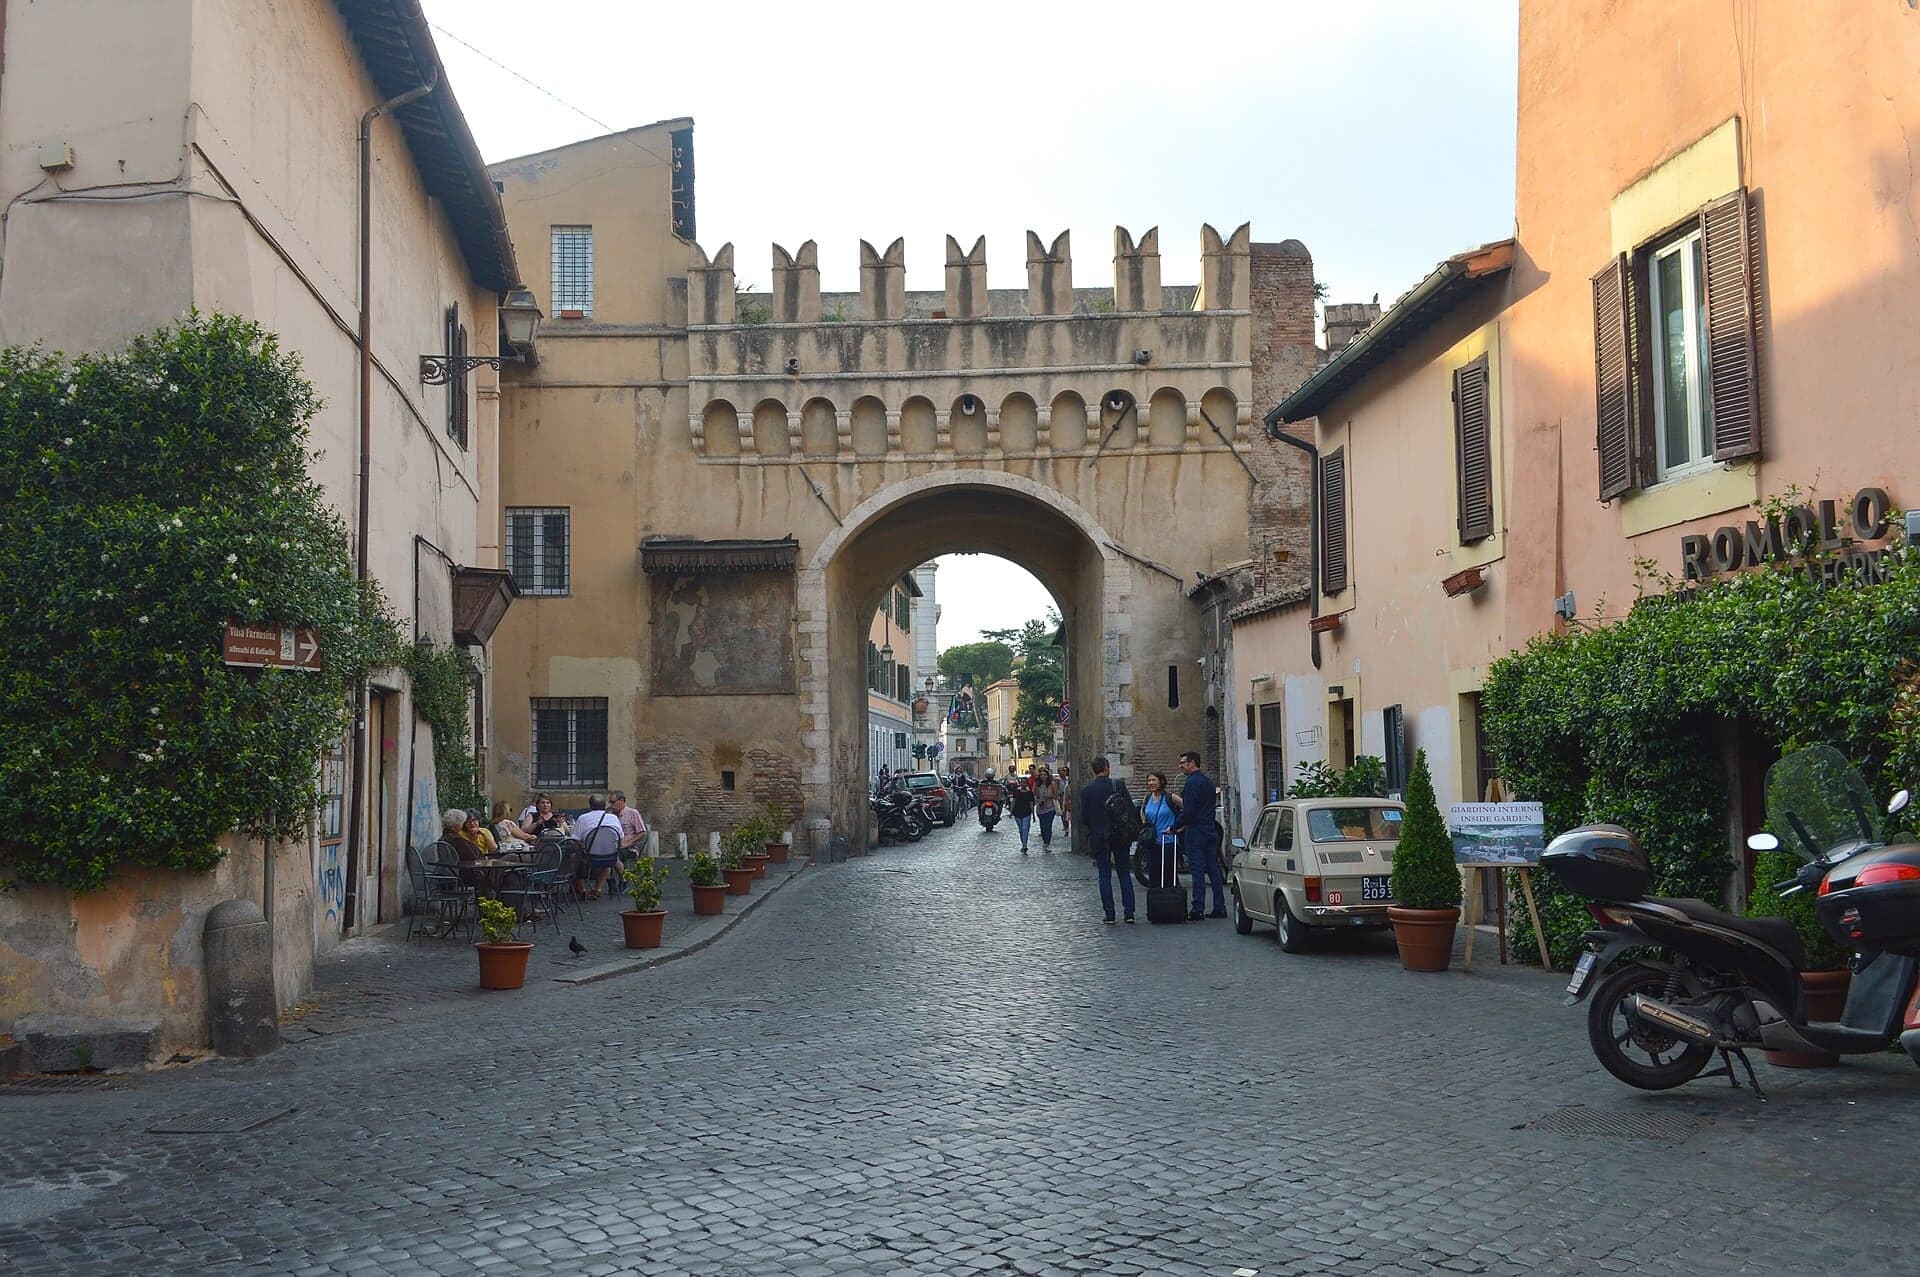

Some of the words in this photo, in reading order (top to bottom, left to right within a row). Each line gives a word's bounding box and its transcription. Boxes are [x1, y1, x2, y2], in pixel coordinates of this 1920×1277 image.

[1681, 487, 1890, 580] ROMOLO
[1451, 806, 1496, 814] GIARDINO
[1498, 805, 1541, 813] INTERNO
[1461, 815, 1492, 823] INSIDE
[1494, 815, 1533, 823] GARDEN
[1329, 893, 1341, 904] 80
